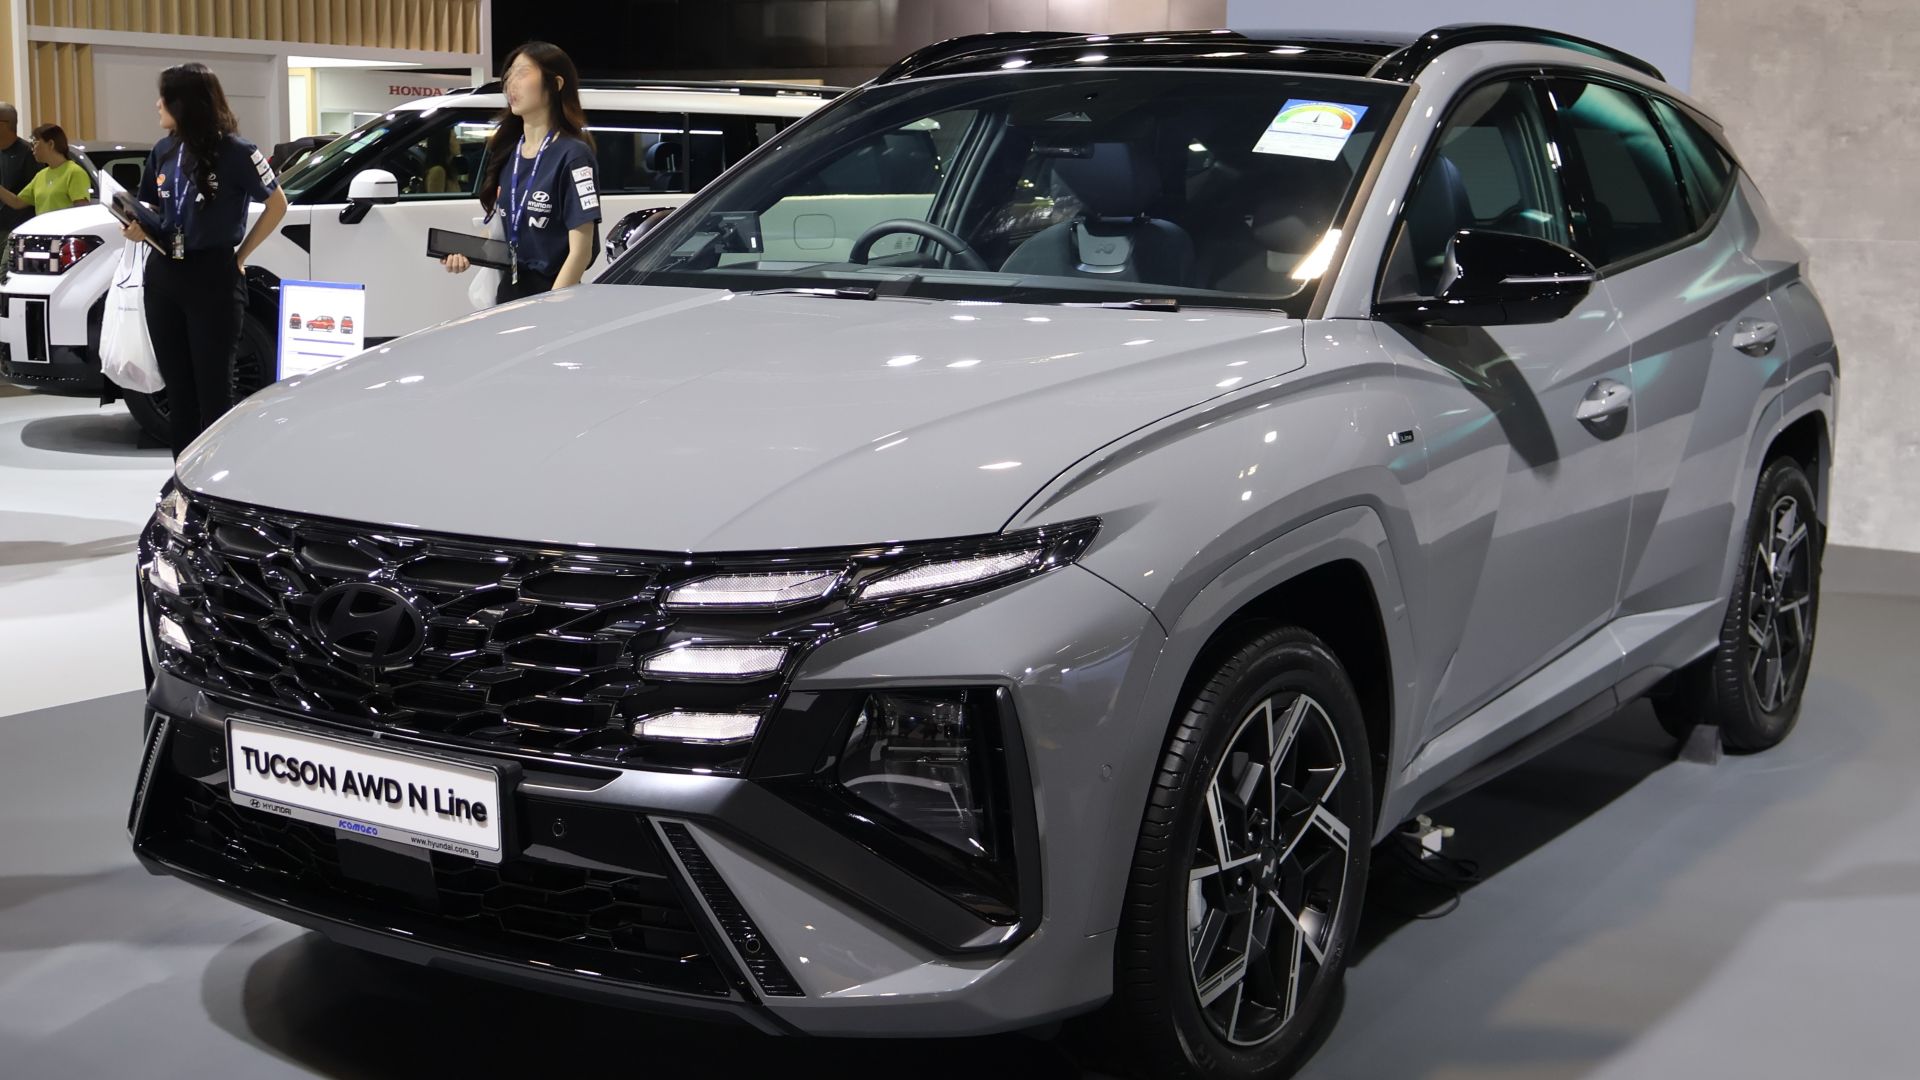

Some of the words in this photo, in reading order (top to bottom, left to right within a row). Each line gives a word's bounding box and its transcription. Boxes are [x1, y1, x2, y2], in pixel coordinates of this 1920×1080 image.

[389, 86, 443, 97] HONDA
[240, 745, 337, 791] TUCSON
[342, 770, 403, 804] AWD
[408, 782, 428, 811] N
[433, 787, 488, 822] Line
[262, 802, 292, 815] HYUNDAI
[410, 836, 479, 858] www.hyundai.com.sg
